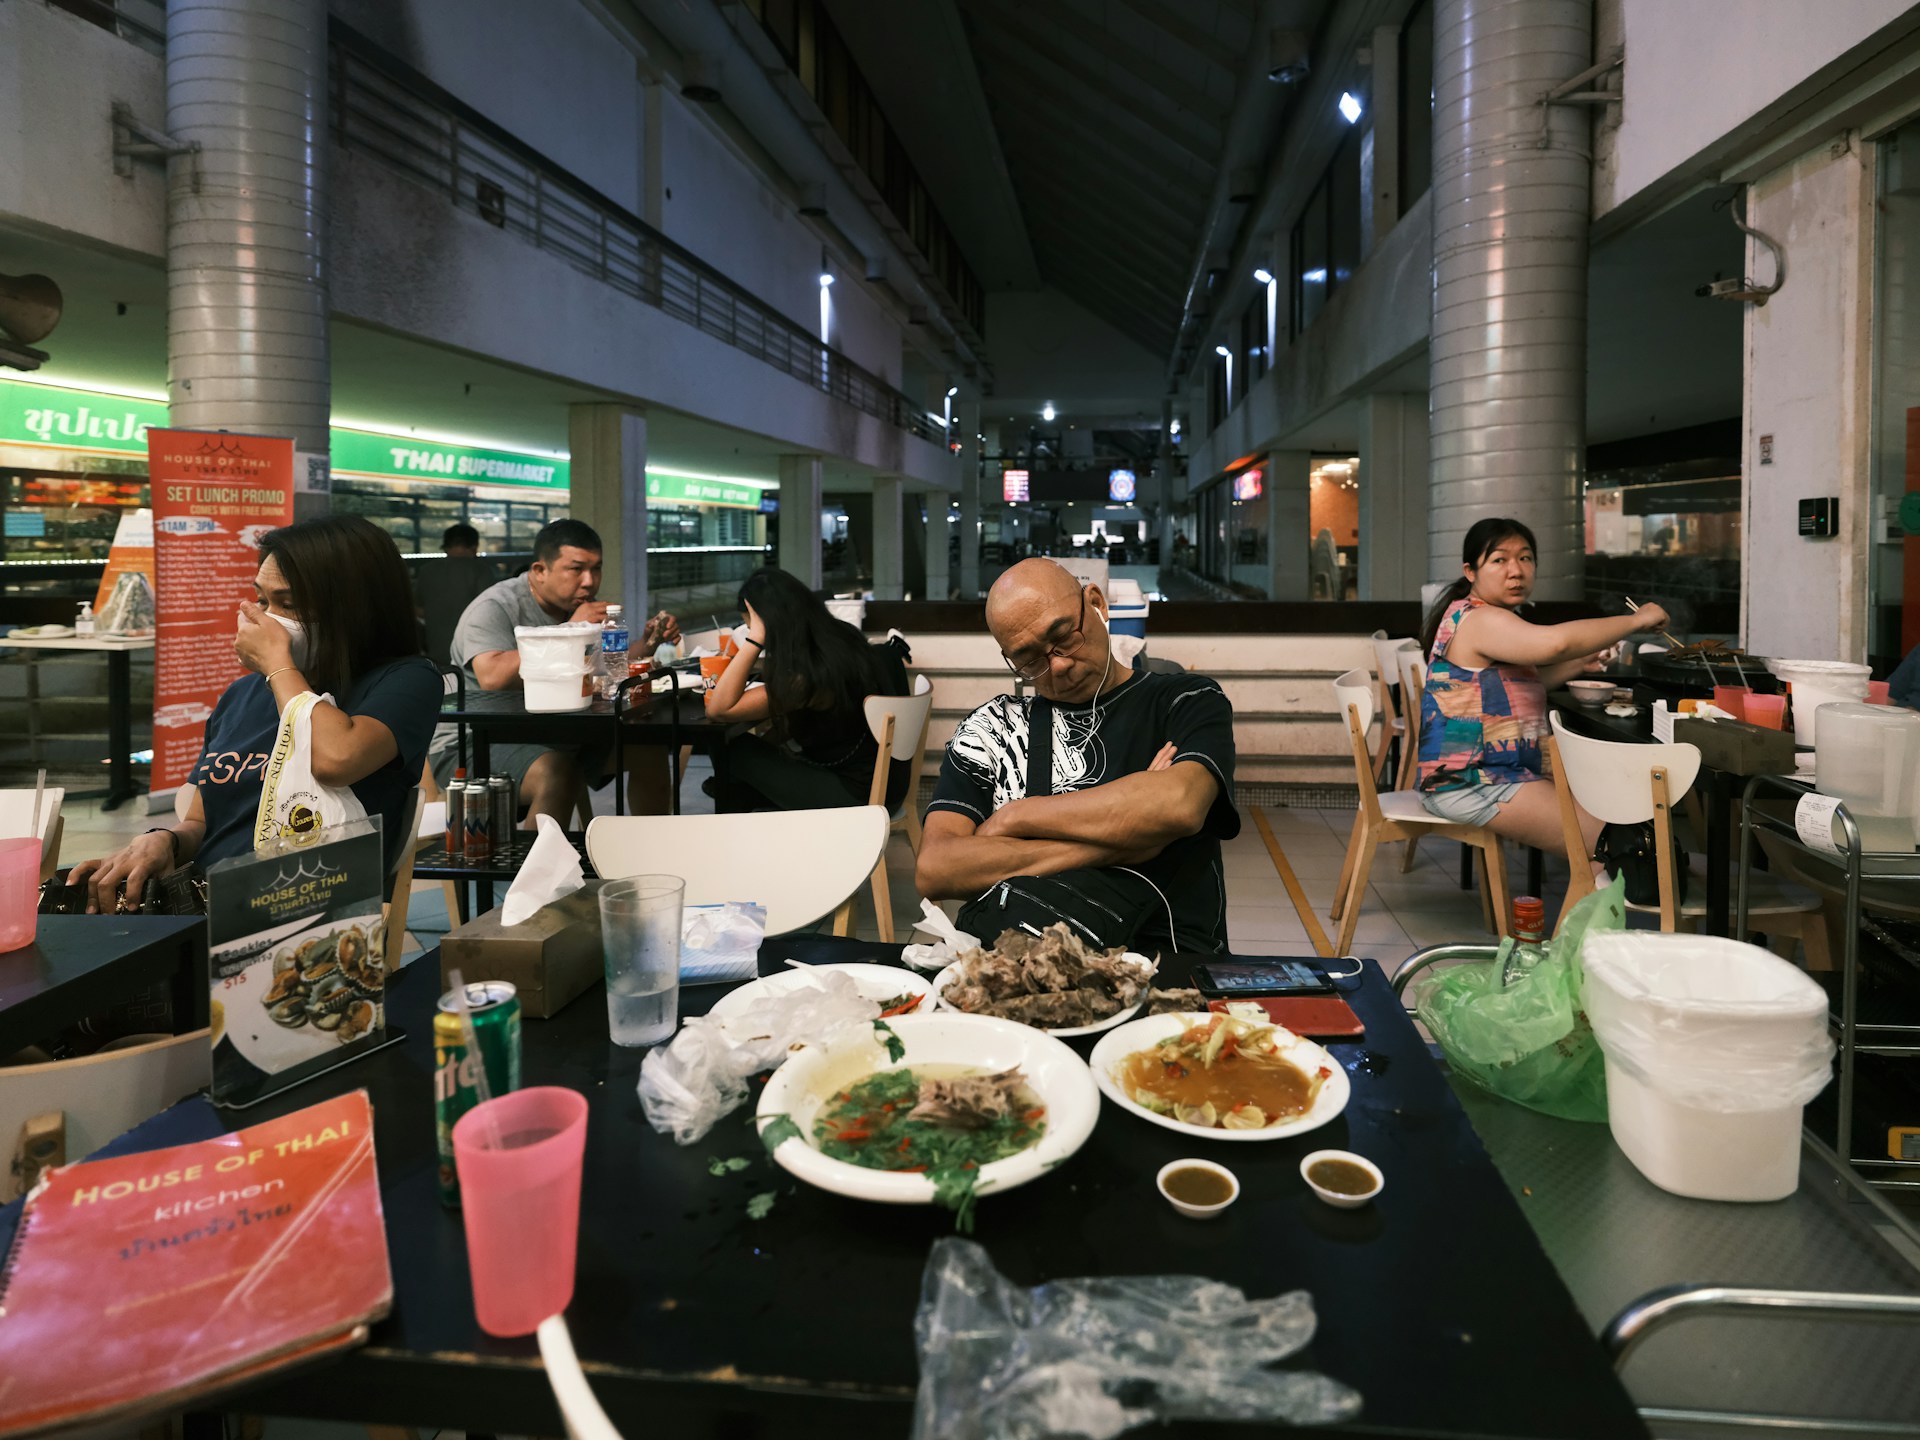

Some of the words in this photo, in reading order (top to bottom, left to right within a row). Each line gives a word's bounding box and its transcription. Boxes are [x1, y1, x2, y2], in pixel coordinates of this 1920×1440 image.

[164, 455, 211, 465] HOUSE
[218, 457, 235, 466] OF
[242, 459, 271, 468] THAI
[390, 447, 454, 474] THAI
[457, 456, 555, 484] SUPERMARKET
[167, 486, 192, 502] SET
[196, 487, 238, 503] LUNCH
[242, 489, 285, 505] PROMO
[190, 505, 218, 515] COMES
[220, 505, 240, 515] WITH
[241, 506, 260, 516] FREE
[261, 507, 285, 516] DRINK
[161, 521, 187, 531] 11AM
[196, 521, 215, 531] 3PM
[272, 723, 292, 780] GOLDEN
[258, 785, 276, 842] BANANA
[250, 886, 297, 909] HOUSE
[300, 881, 317, 894] OF
[320, 872, 348, 888] THAI
[71, 1164, 203, 1208] HOUSE
[215, 1151, 265, 1173] OF
[274, 1120, 350, 1158] THAI
[153, 1178, 285, 1223] kitchen
